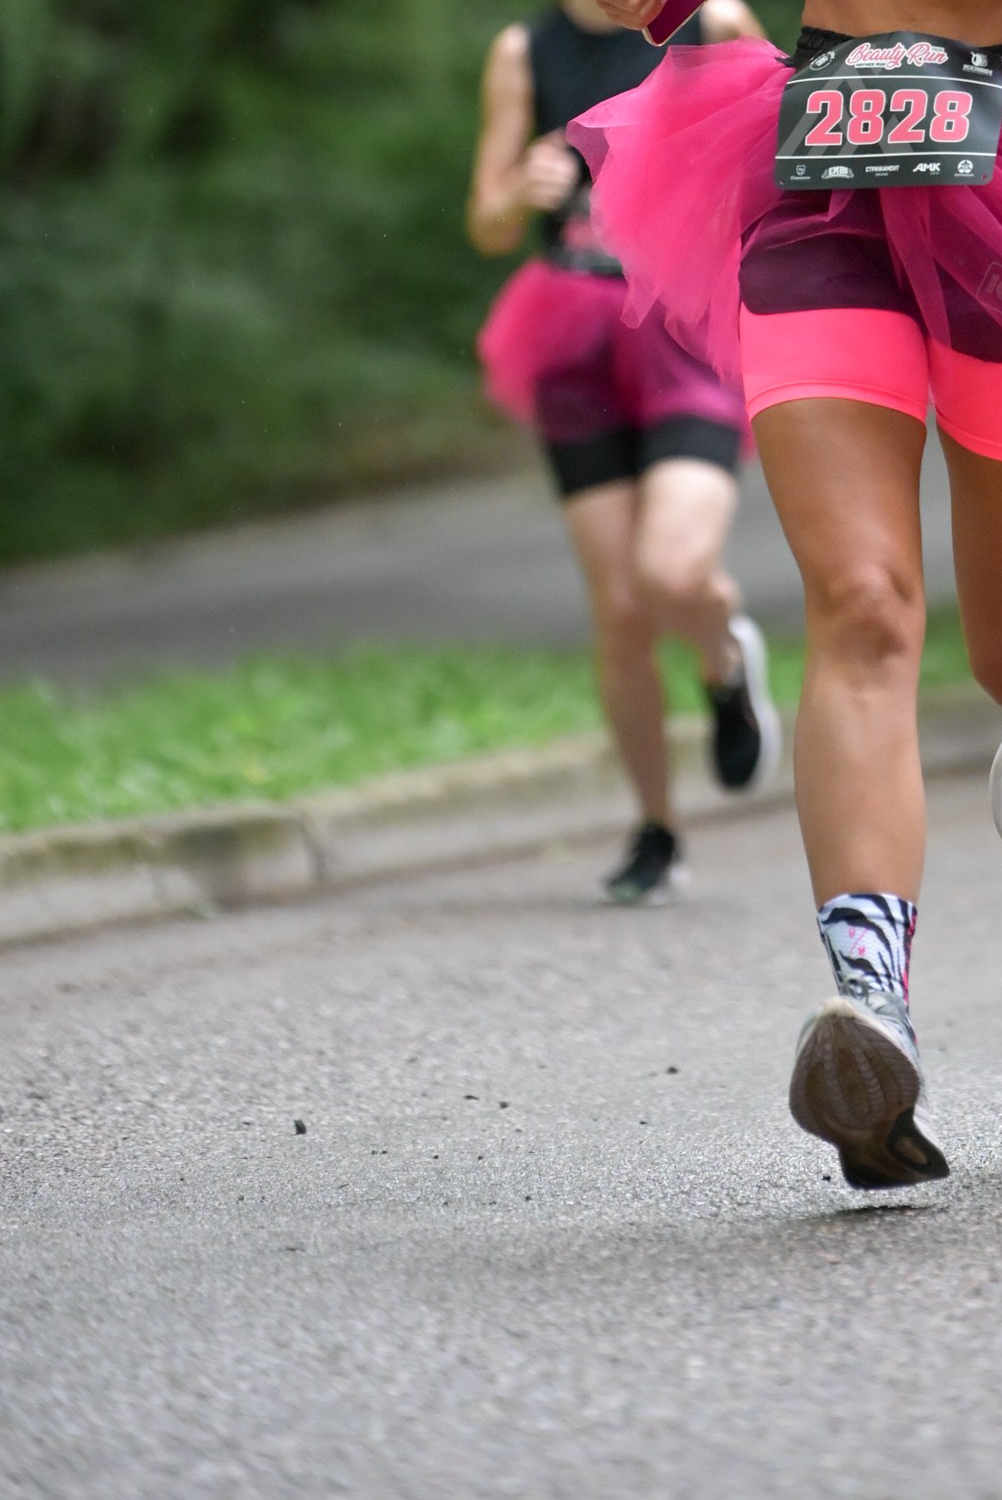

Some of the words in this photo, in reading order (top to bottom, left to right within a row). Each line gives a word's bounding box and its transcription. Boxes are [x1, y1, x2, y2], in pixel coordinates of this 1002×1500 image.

[846, 43, 905, 69] Beauty
[907, 42, 948, 66] Run
[805, 89, 973, 146] 2828
